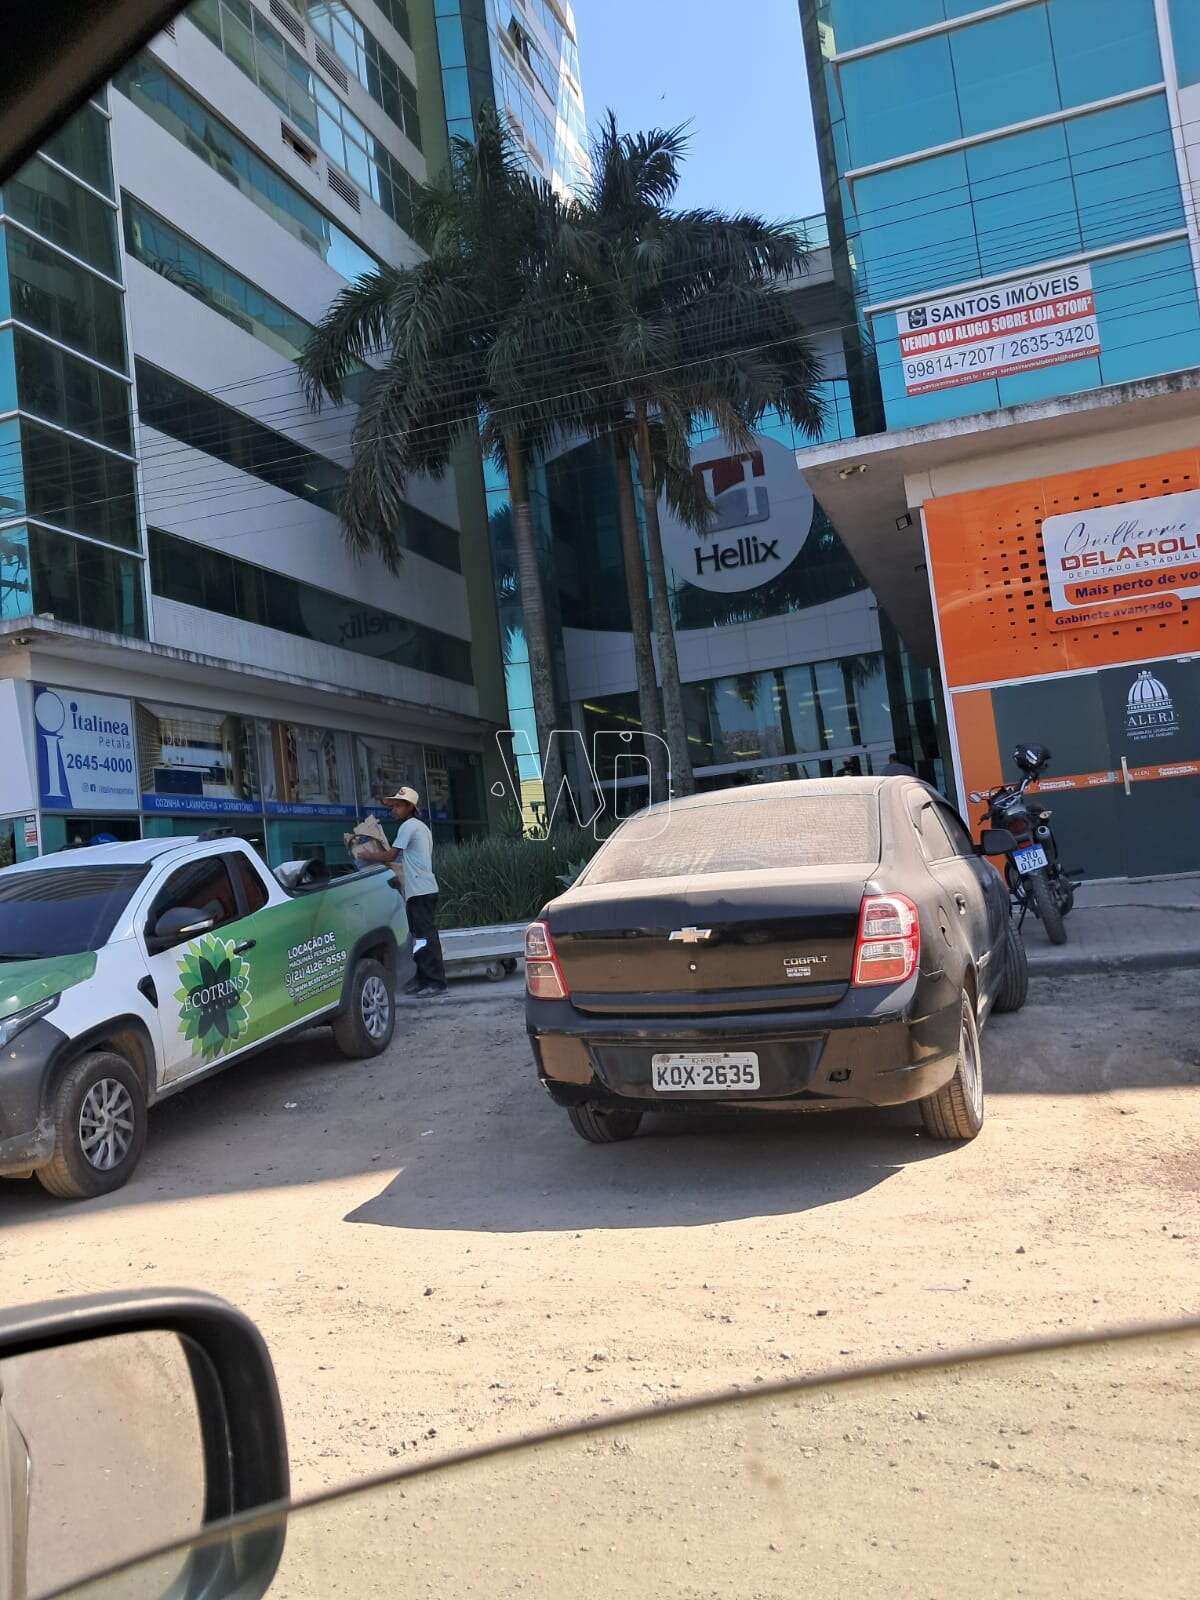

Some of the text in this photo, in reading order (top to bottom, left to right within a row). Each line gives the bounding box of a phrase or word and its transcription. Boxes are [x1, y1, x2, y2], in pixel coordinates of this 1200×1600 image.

[931, 275, 1079, 323] SANTOS IMÓVEIS
[901, 332, 937, 352] VENDO
[938, 328, 953, 344] OU
[955, 320, 990, 340] ALUGO
[991, 311, 1028, 332] SOBRE
[1029, 305, 1055, 323] LOJA
[907, 347, 995, 379] 99814-7207
[1010, 324, 1094, 357] 2635-3420
[695, 536, 781, 576] Hellix
[1068, 551, 1198, 579] DEPUTADO ESTADUAL
[1075, 583, 1109, 599] Mais
[1113, 576, 1153, 595] perto
[1158, 573, 1177, 585] de
[1055, 600, 1173, 626] Gabinete avançado
[1128, 711, 1175, 727] ALERJ
[66, 753, 133, 773] 2645-4000
[288, 931, 336, 959] LOCAÇÃO DE
[291, 950, 347, 983] (21) 4126-9559
[783, 955, 828, 966] COBALT
[184, 974, 245, 1012] ECOTRINS
